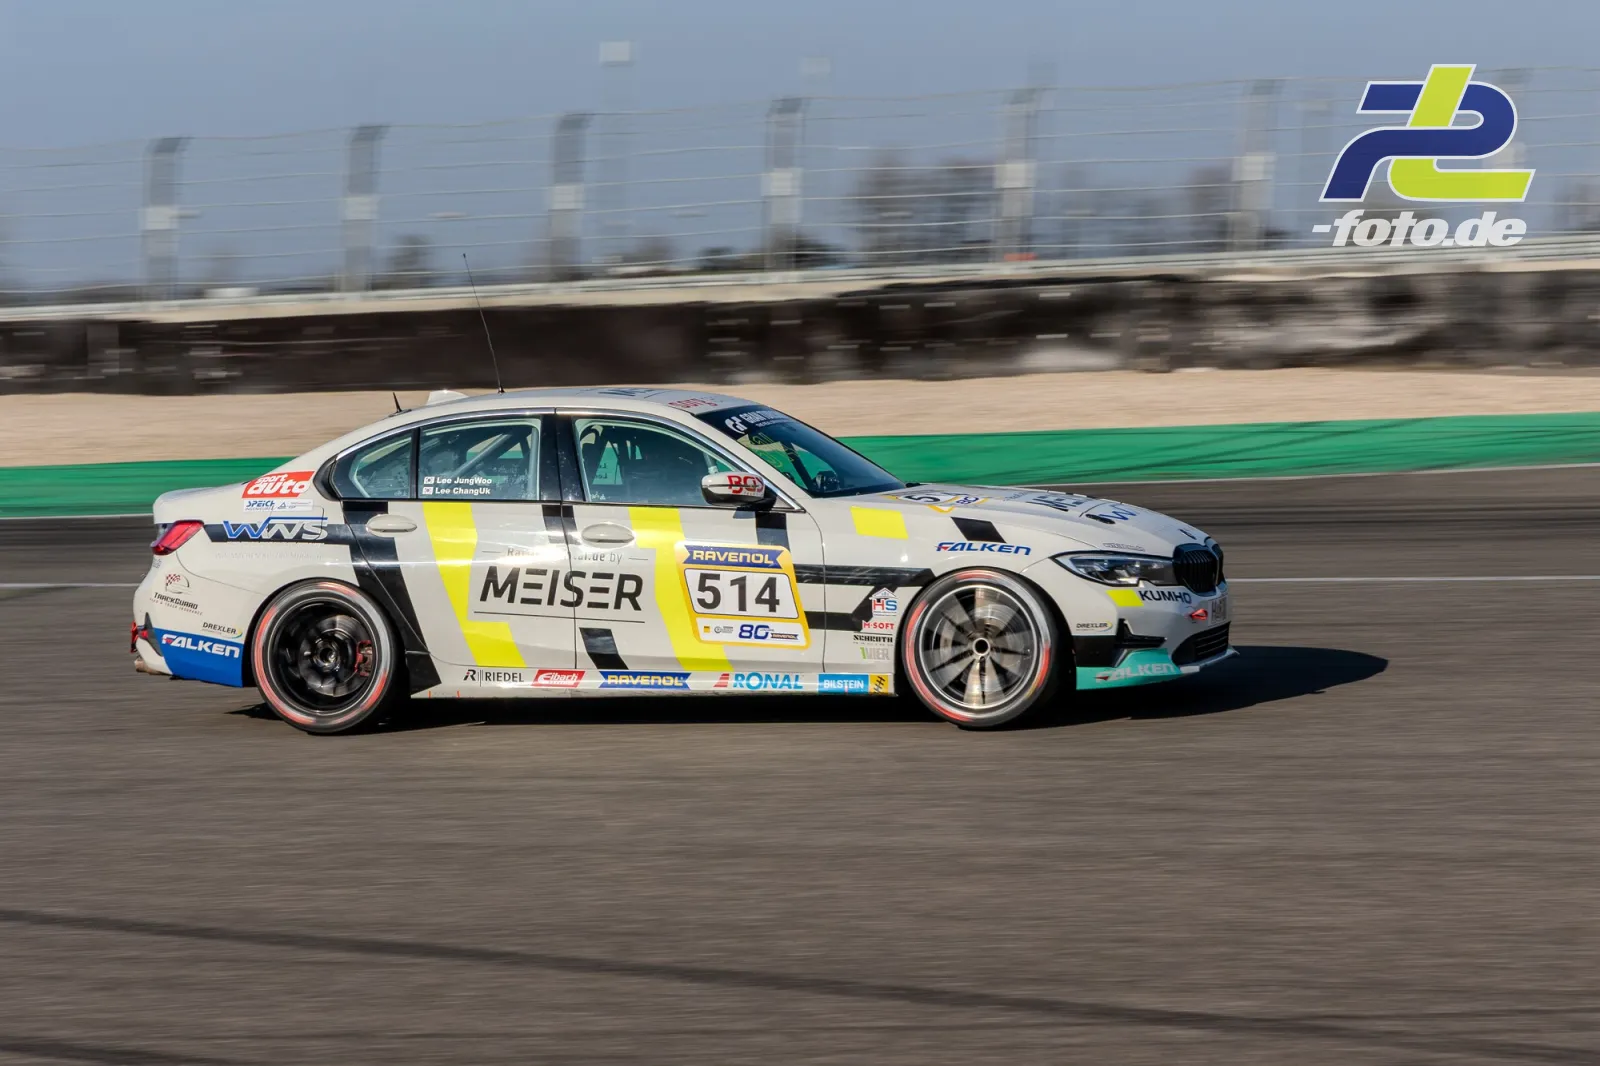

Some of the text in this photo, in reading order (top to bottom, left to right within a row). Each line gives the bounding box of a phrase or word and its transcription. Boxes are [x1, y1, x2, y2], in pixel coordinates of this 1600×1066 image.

[256, 474, 289, 484] sport
[454, 477, 492, 486] JungWoo
[247, 479, 311, 495] auto
[453, 487, 491, 496] ChangUk
[222, 516, 328, 540] WWS
[935, 541, 1032, 556] FALKEN
[692, 550, 774, 564] RAVENOL
[479, 565, 643, 611] MEISER
[696, 572, 780, 613] 514
[1137, 590, 1192, 604] KUMHO
[873, 599, 898, 611] HS
[202, 622, 237, 635] DREXLER
[161, 633, 240, 659] FALKEN
[485, 671, 525, 683] RIEDEL
[537, 672, 579, 684] Eibach
[607, 674, 684, 687] RAVENOL
[732, 671, 804, 690] RONAL
[1095, 663, 1176, 684] FALKEN
[823, 679, 864, 689] BILSTEIN
